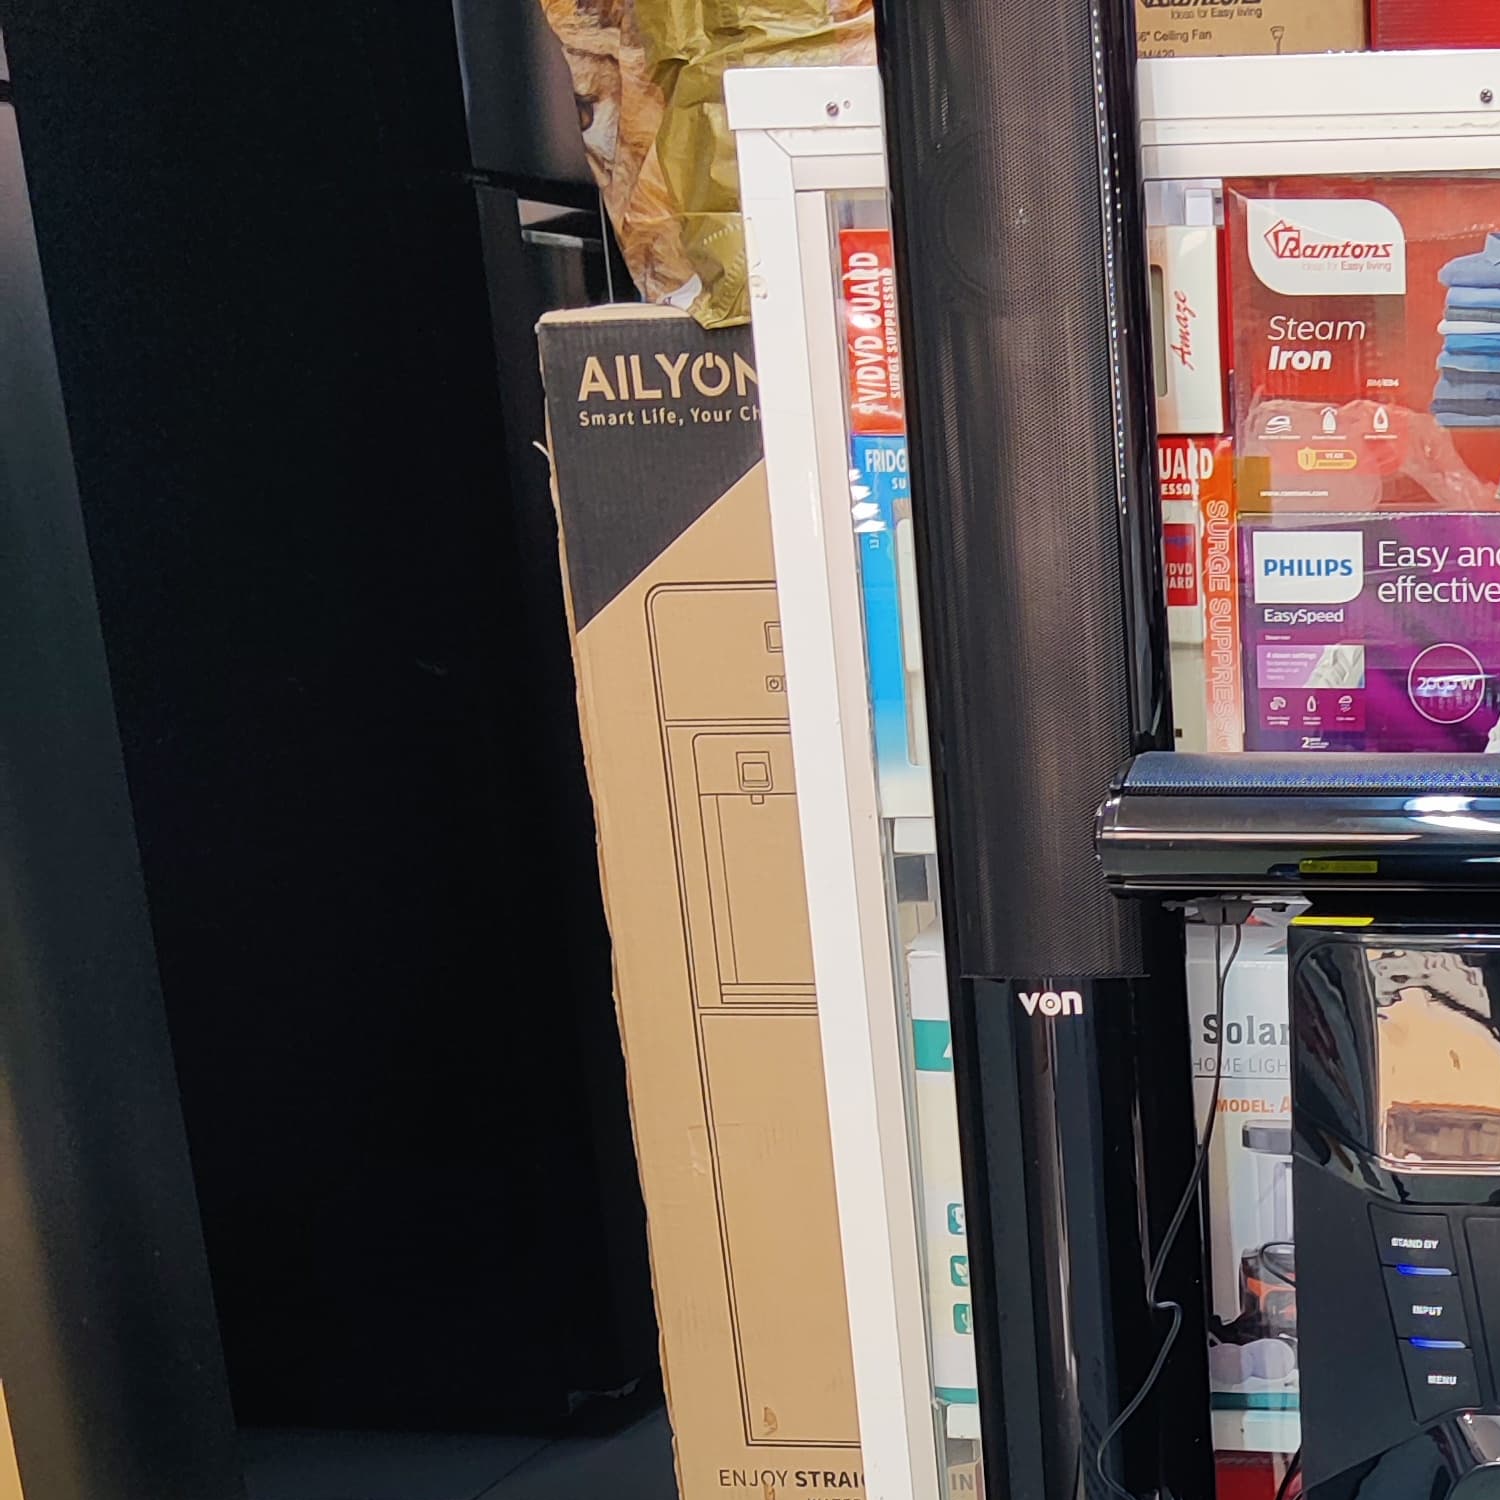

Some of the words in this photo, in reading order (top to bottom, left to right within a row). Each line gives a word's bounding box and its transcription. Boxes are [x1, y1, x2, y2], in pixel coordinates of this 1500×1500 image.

[1192, 29, 1212, 40] Fan
[1279, 240, 1393, 260] Ramtons
[1340, 261, 1368, 273] Easy
[1370, 260, 1392, 273] living
[1170, 290, 1197, 370] Amaze
[1267, 316, 1366, 341] Steam
[1267, 346, 1332, 371] Iron
[577, 353, 759, 401] AILYON
[886, 357, 901, 399] SURGE
[579, 409, 635, 427] Smart
[642, 408, 684, 426] Life,
[690, 408, 733, 423] Your
[1207, 500, 1231, 592] SURGE
[1377, 540, 1451, 572] Easy
[1264, 559, 1353, 577] PHILIPS
[1264, 608, 1345, 625] EasySpeed
[1461, 677, 1476, 690] W
[1203, 1014, 1289, 1046] Solar
[1215, 1096, 1275, 1113] MODEL:
[719, 1469, 788, 1487] ENJOY
[795, 1471, 865, 1488] STRAI
